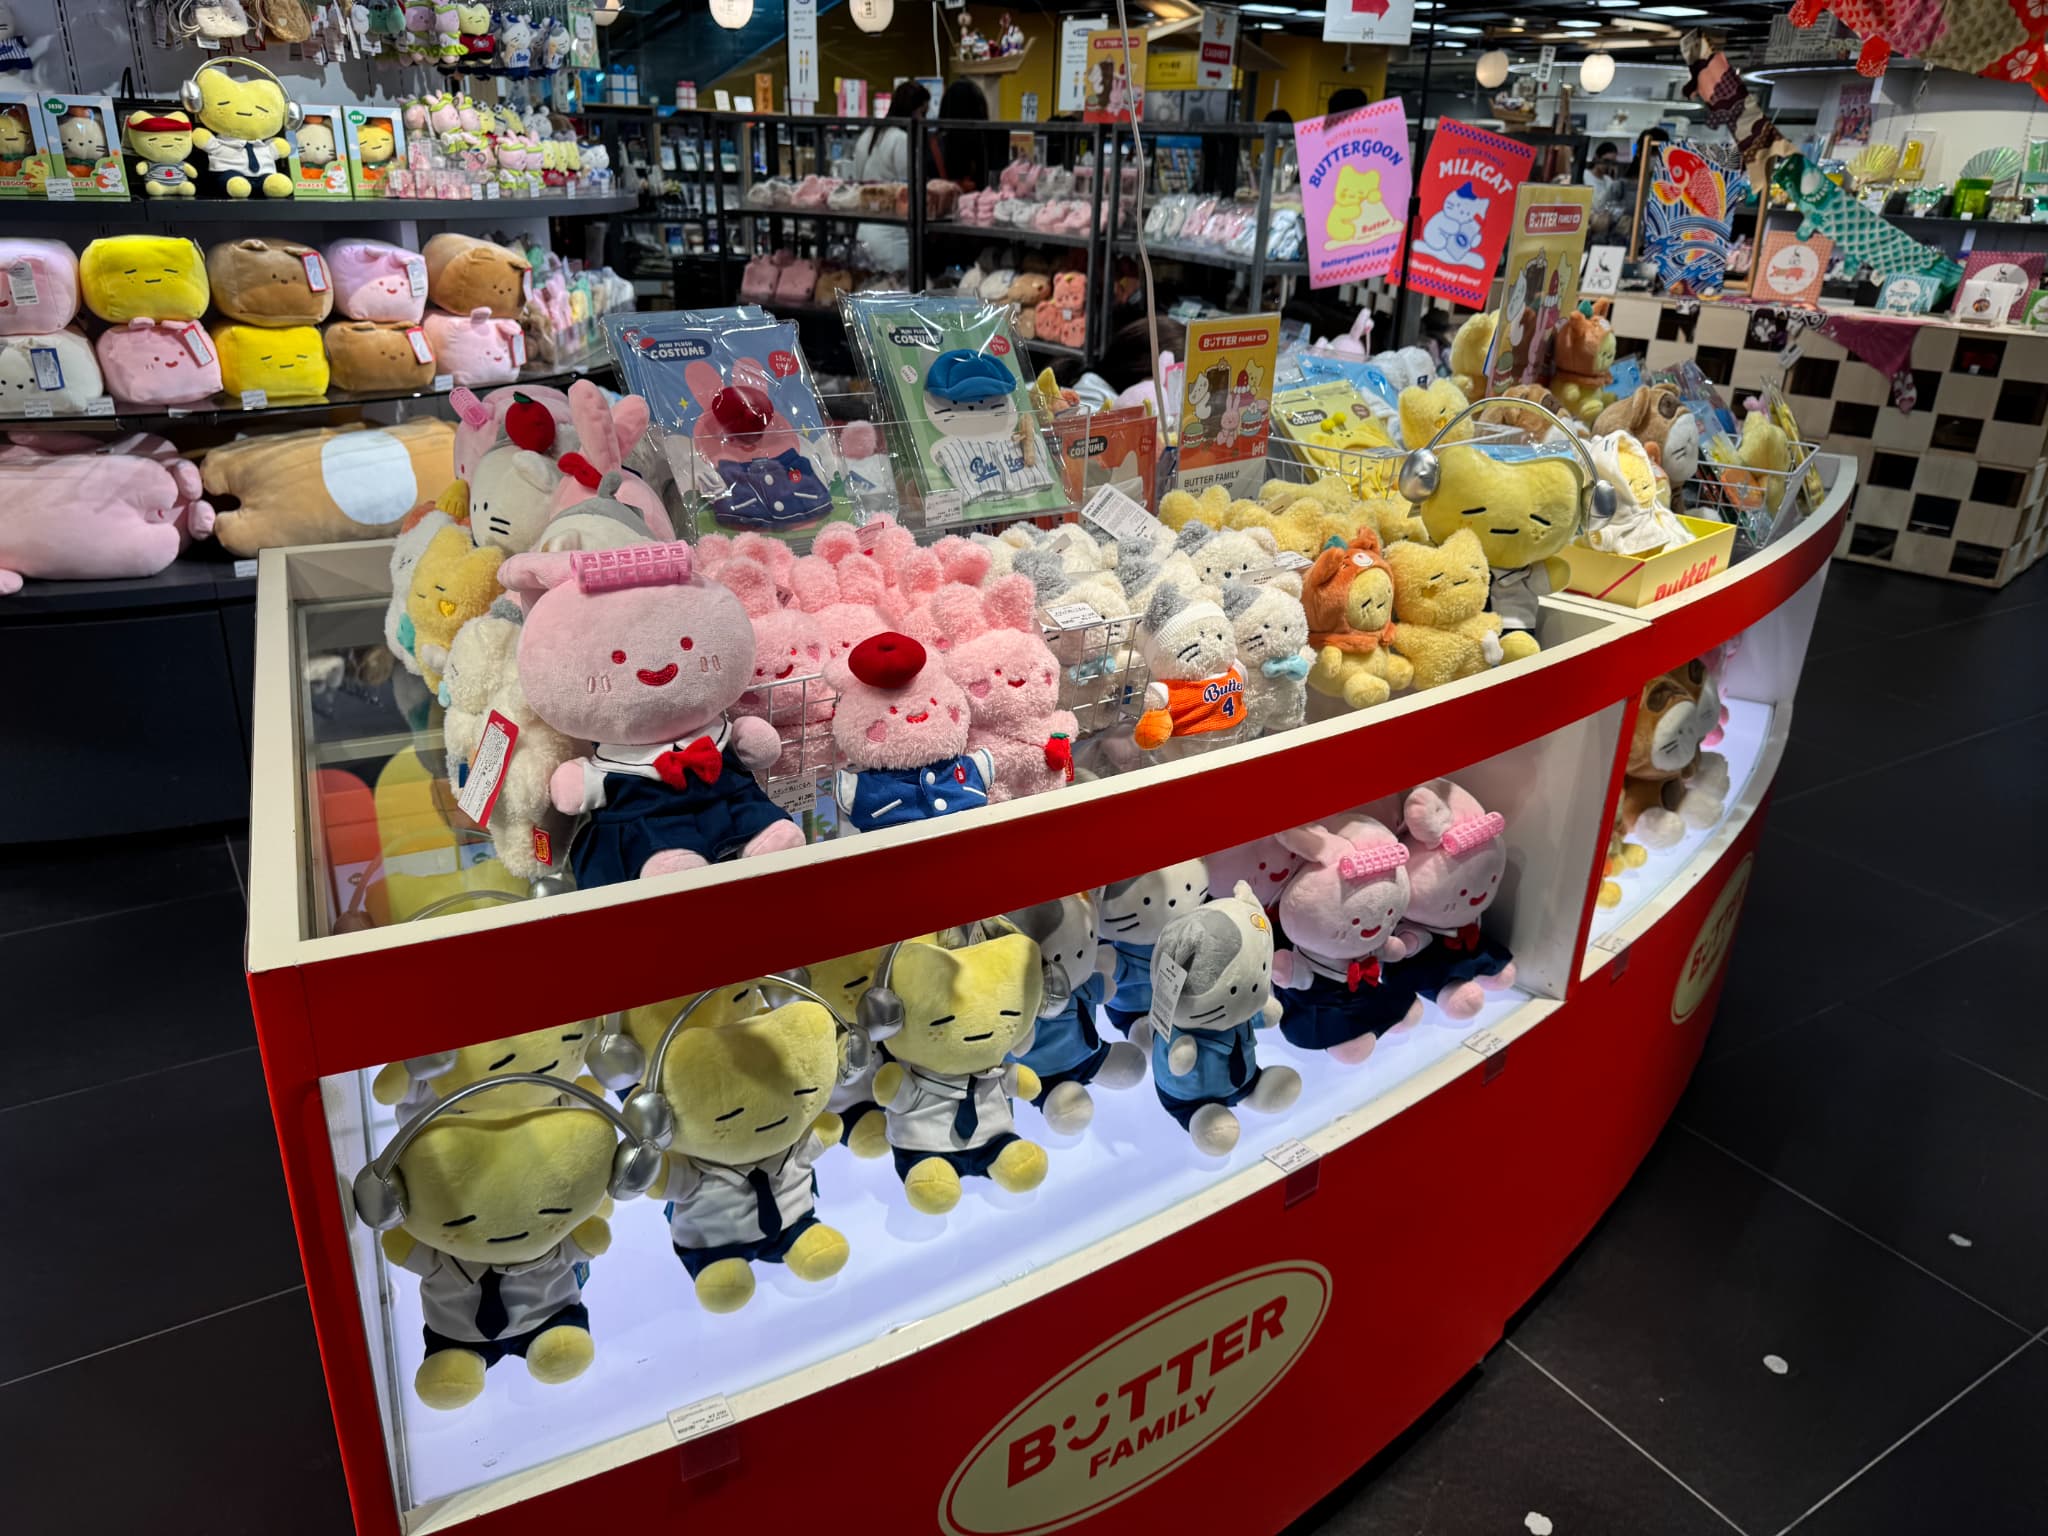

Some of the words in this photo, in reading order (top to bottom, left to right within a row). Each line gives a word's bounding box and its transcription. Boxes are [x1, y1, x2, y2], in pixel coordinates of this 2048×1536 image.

[1309, 139, 1404, 189] BUTTERGOON
[1438, 158, 1514, 195] MILKCAT
[894, 334, 940, 344] COSTUME
[1203, 335, 1237, 349] BUTTER
[651, 346, 705, 360] COSTUME
[1183, 474, 1214, 488] BUTTER
[1215, 469, 1240, 483] FAMILY
[1222, 696, 1235, 718] 4
[1088, 1386, 1216, 1479] FAMILY
